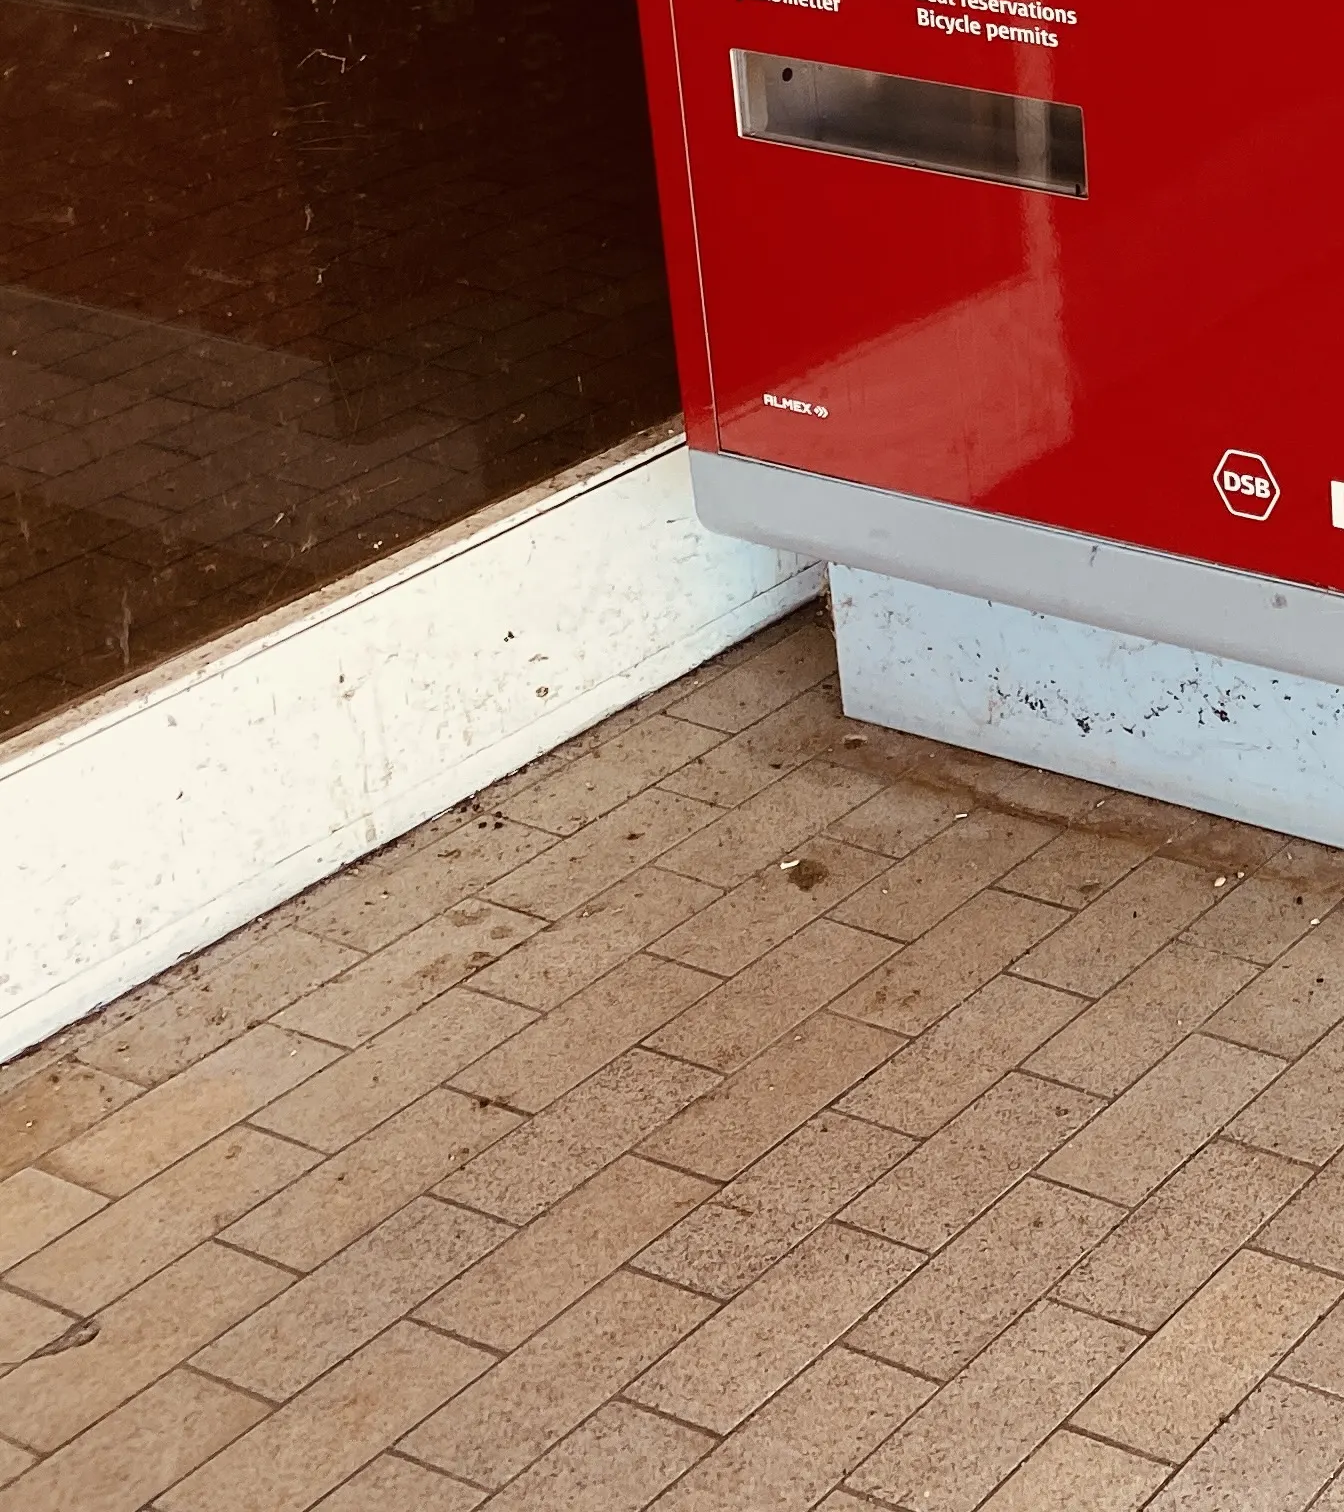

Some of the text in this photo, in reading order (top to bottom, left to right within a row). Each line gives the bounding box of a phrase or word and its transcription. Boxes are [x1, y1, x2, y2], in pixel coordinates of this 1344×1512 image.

[917, 7, 1059, 48] Bicycle permits
[763, 393, 813, 416] ALMEX
[1223, 470, 1271, 499] DSB
